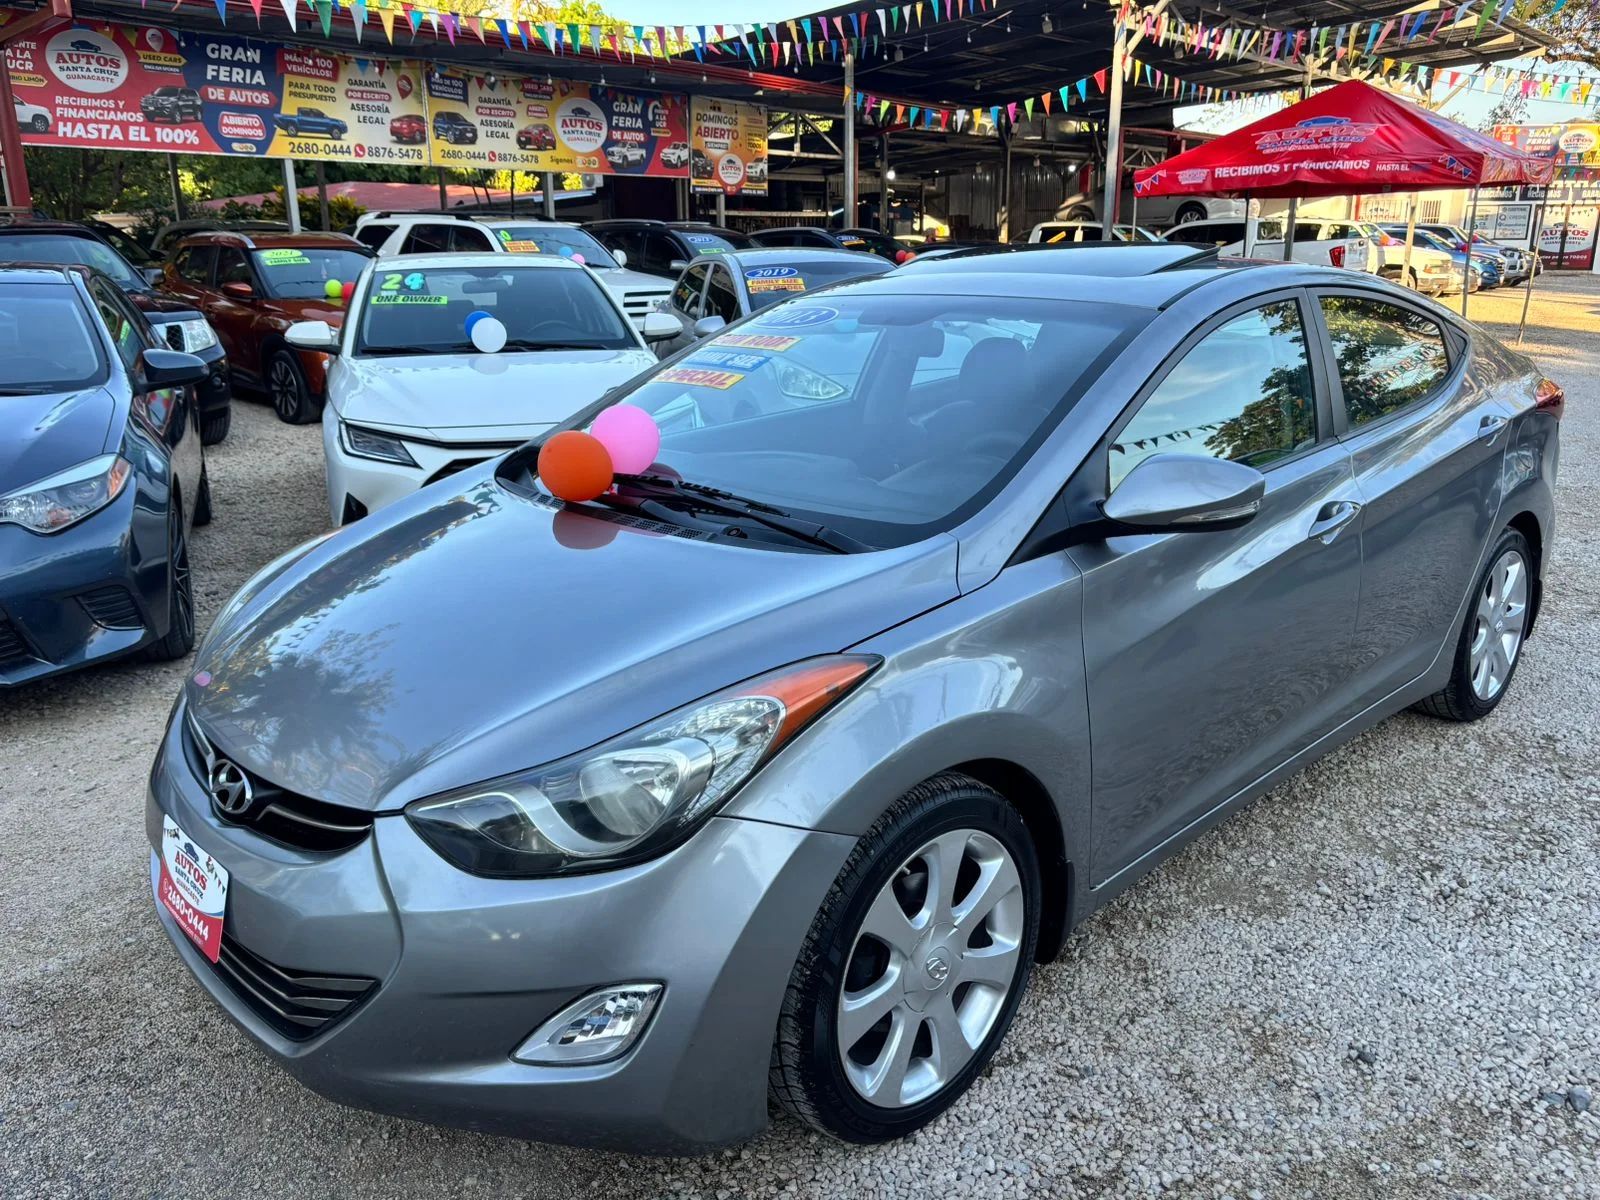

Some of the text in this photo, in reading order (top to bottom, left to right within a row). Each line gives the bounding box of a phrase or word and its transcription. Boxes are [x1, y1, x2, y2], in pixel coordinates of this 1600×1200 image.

[5, 48, 32, 59] A LA
[205, 43, 261, 64] GRAN
[7, 59, 33, 71] UCR
[55, 52, 121, 70] AUTOS
[315, 58, 334, 69] 100
[58, 65, 120, 77] SANTA CRUZ
[206, 64, 267, 86] FERIA
[286, 62, 334, 79] VEHÍCULOS!
[65, 73, 115, 84] GUANACASTE
[347, 77, 387, 90] GARANTÍA
[288, 80, 336, 94] PARA TODO
[55, 95, 125, 109] RECIBIMOS Y
[207, 87, 270, 105] DE AUTOS
[288, 90, 337, 103] PRESUPUESTO
[362, 92, 391, 102] ESCRITO
[478, 96, 512, 107] GARANTÍA
[350, 103, 391, 115] ASESORÍA
[478, 107, 491, 115] POR
[612, 101, 641, 115] GRAN
[56, 107, 144, 123] FINANCIAMOS
[222, 115, 261, 128] ABIERTO
[357, 115, 386, 126] LEGAL
[696, 113, 738, 126] DOMINGOS
[480, 119, 515, 130] ASESORÍA
[561, 118, 603, 131] AUTOS
[612, 116, 643, 129] FERIA
[57, 121, 200, 145] HASTA EL 100%
[485, 131, 511, 140] LEGAL
[612, 131, 622, 139] DE
[622, 132, 645, 141] AUTOS
[695, 126, 739, 140] ABIERTO
[1255, 126, 1380, 145] AUTOS
[288, 140, 424, 161] 2680-0444 8876-5478
[441, 149, 540, 165] 2680-0444 8876-5478
[1214, 163, 1280, 178] RECIBIMOS
[1283, 163, 1291, 173] Y
[1376, 163, 1410, 172] HASTA EL
[755, 268, 789, 277] 2019
[751, 278, 779, 286] FAMILY
[376, 295, 442, 303] ONE OWNER
[656, 368, 735, 387] SPECIAL
[175, 850, 208, 891] AUTOS
[174, 865, 204, 900] SANTA CRUZ
[167, 884, 209, 941] 2680-0444
